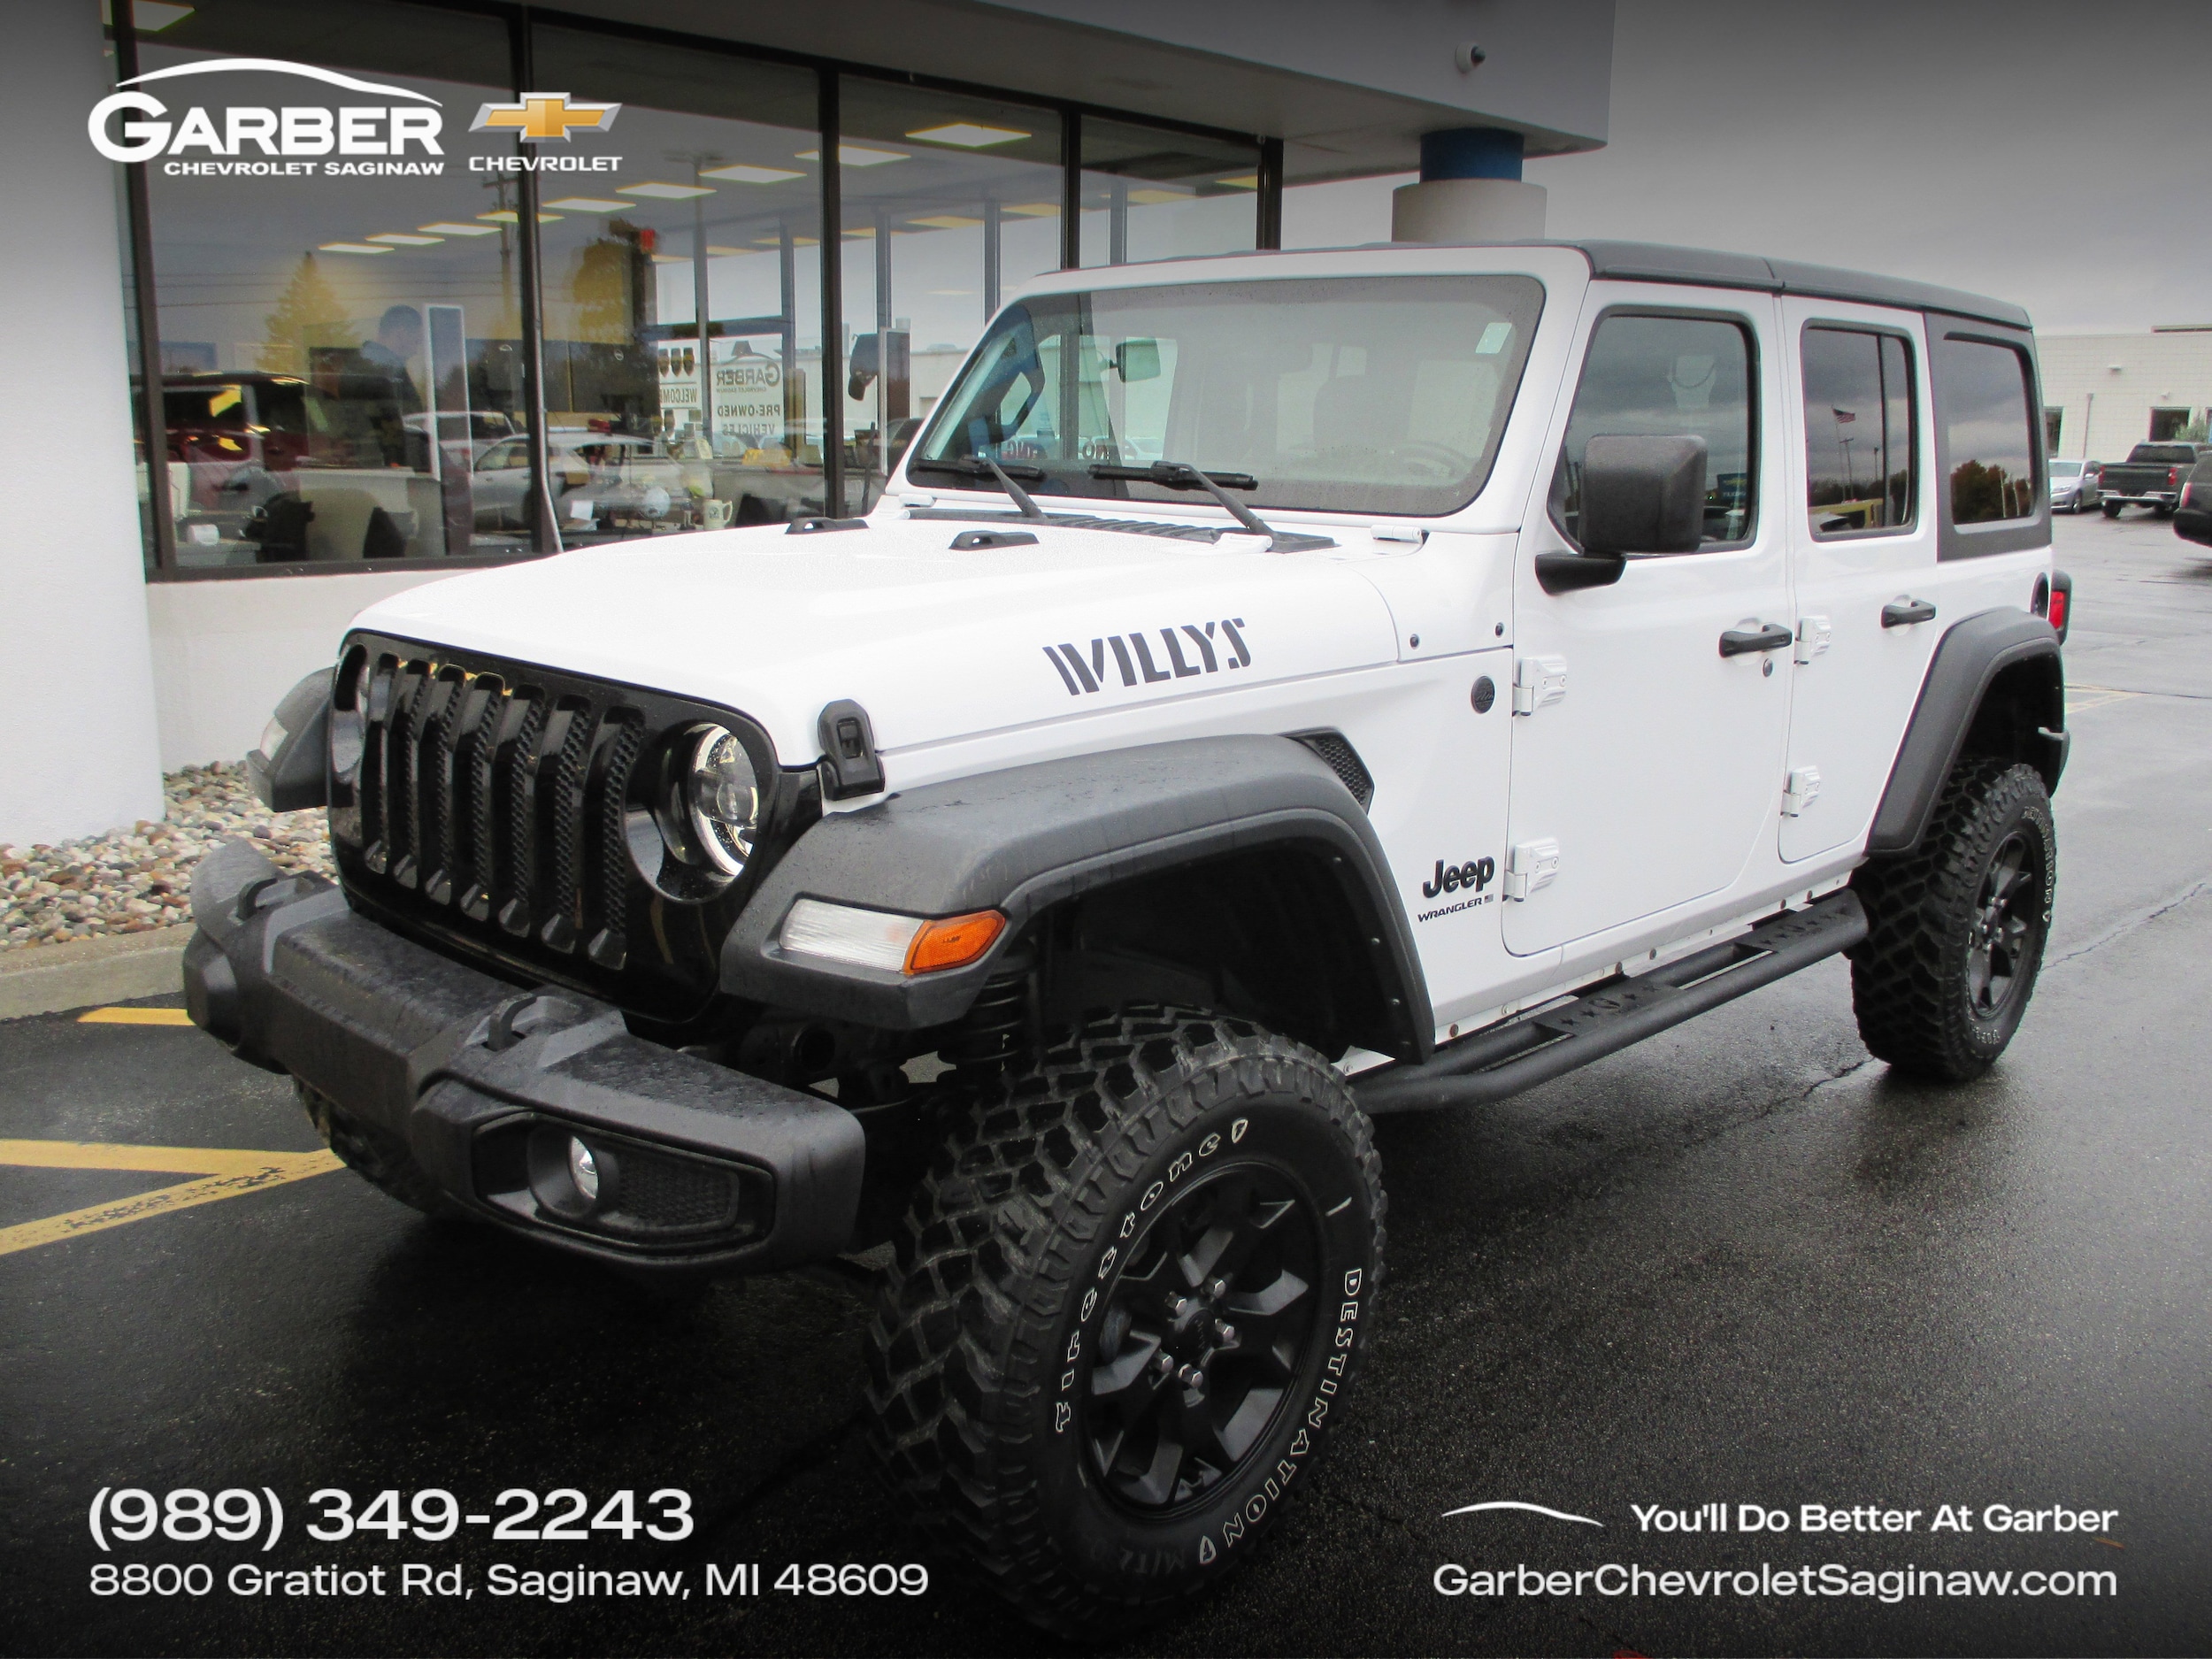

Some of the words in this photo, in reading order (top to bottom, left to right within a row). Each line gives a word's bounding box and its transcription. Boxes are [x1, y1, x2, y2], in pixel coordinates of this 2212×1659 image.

[1041, 618, 1252, 696] WILLYS
[1422, 855, 1495, 899] Jeep
[1417, 896, 1483, 923] WRANGLER
[1221, 1267, 1363, 1549] DESTINATION
